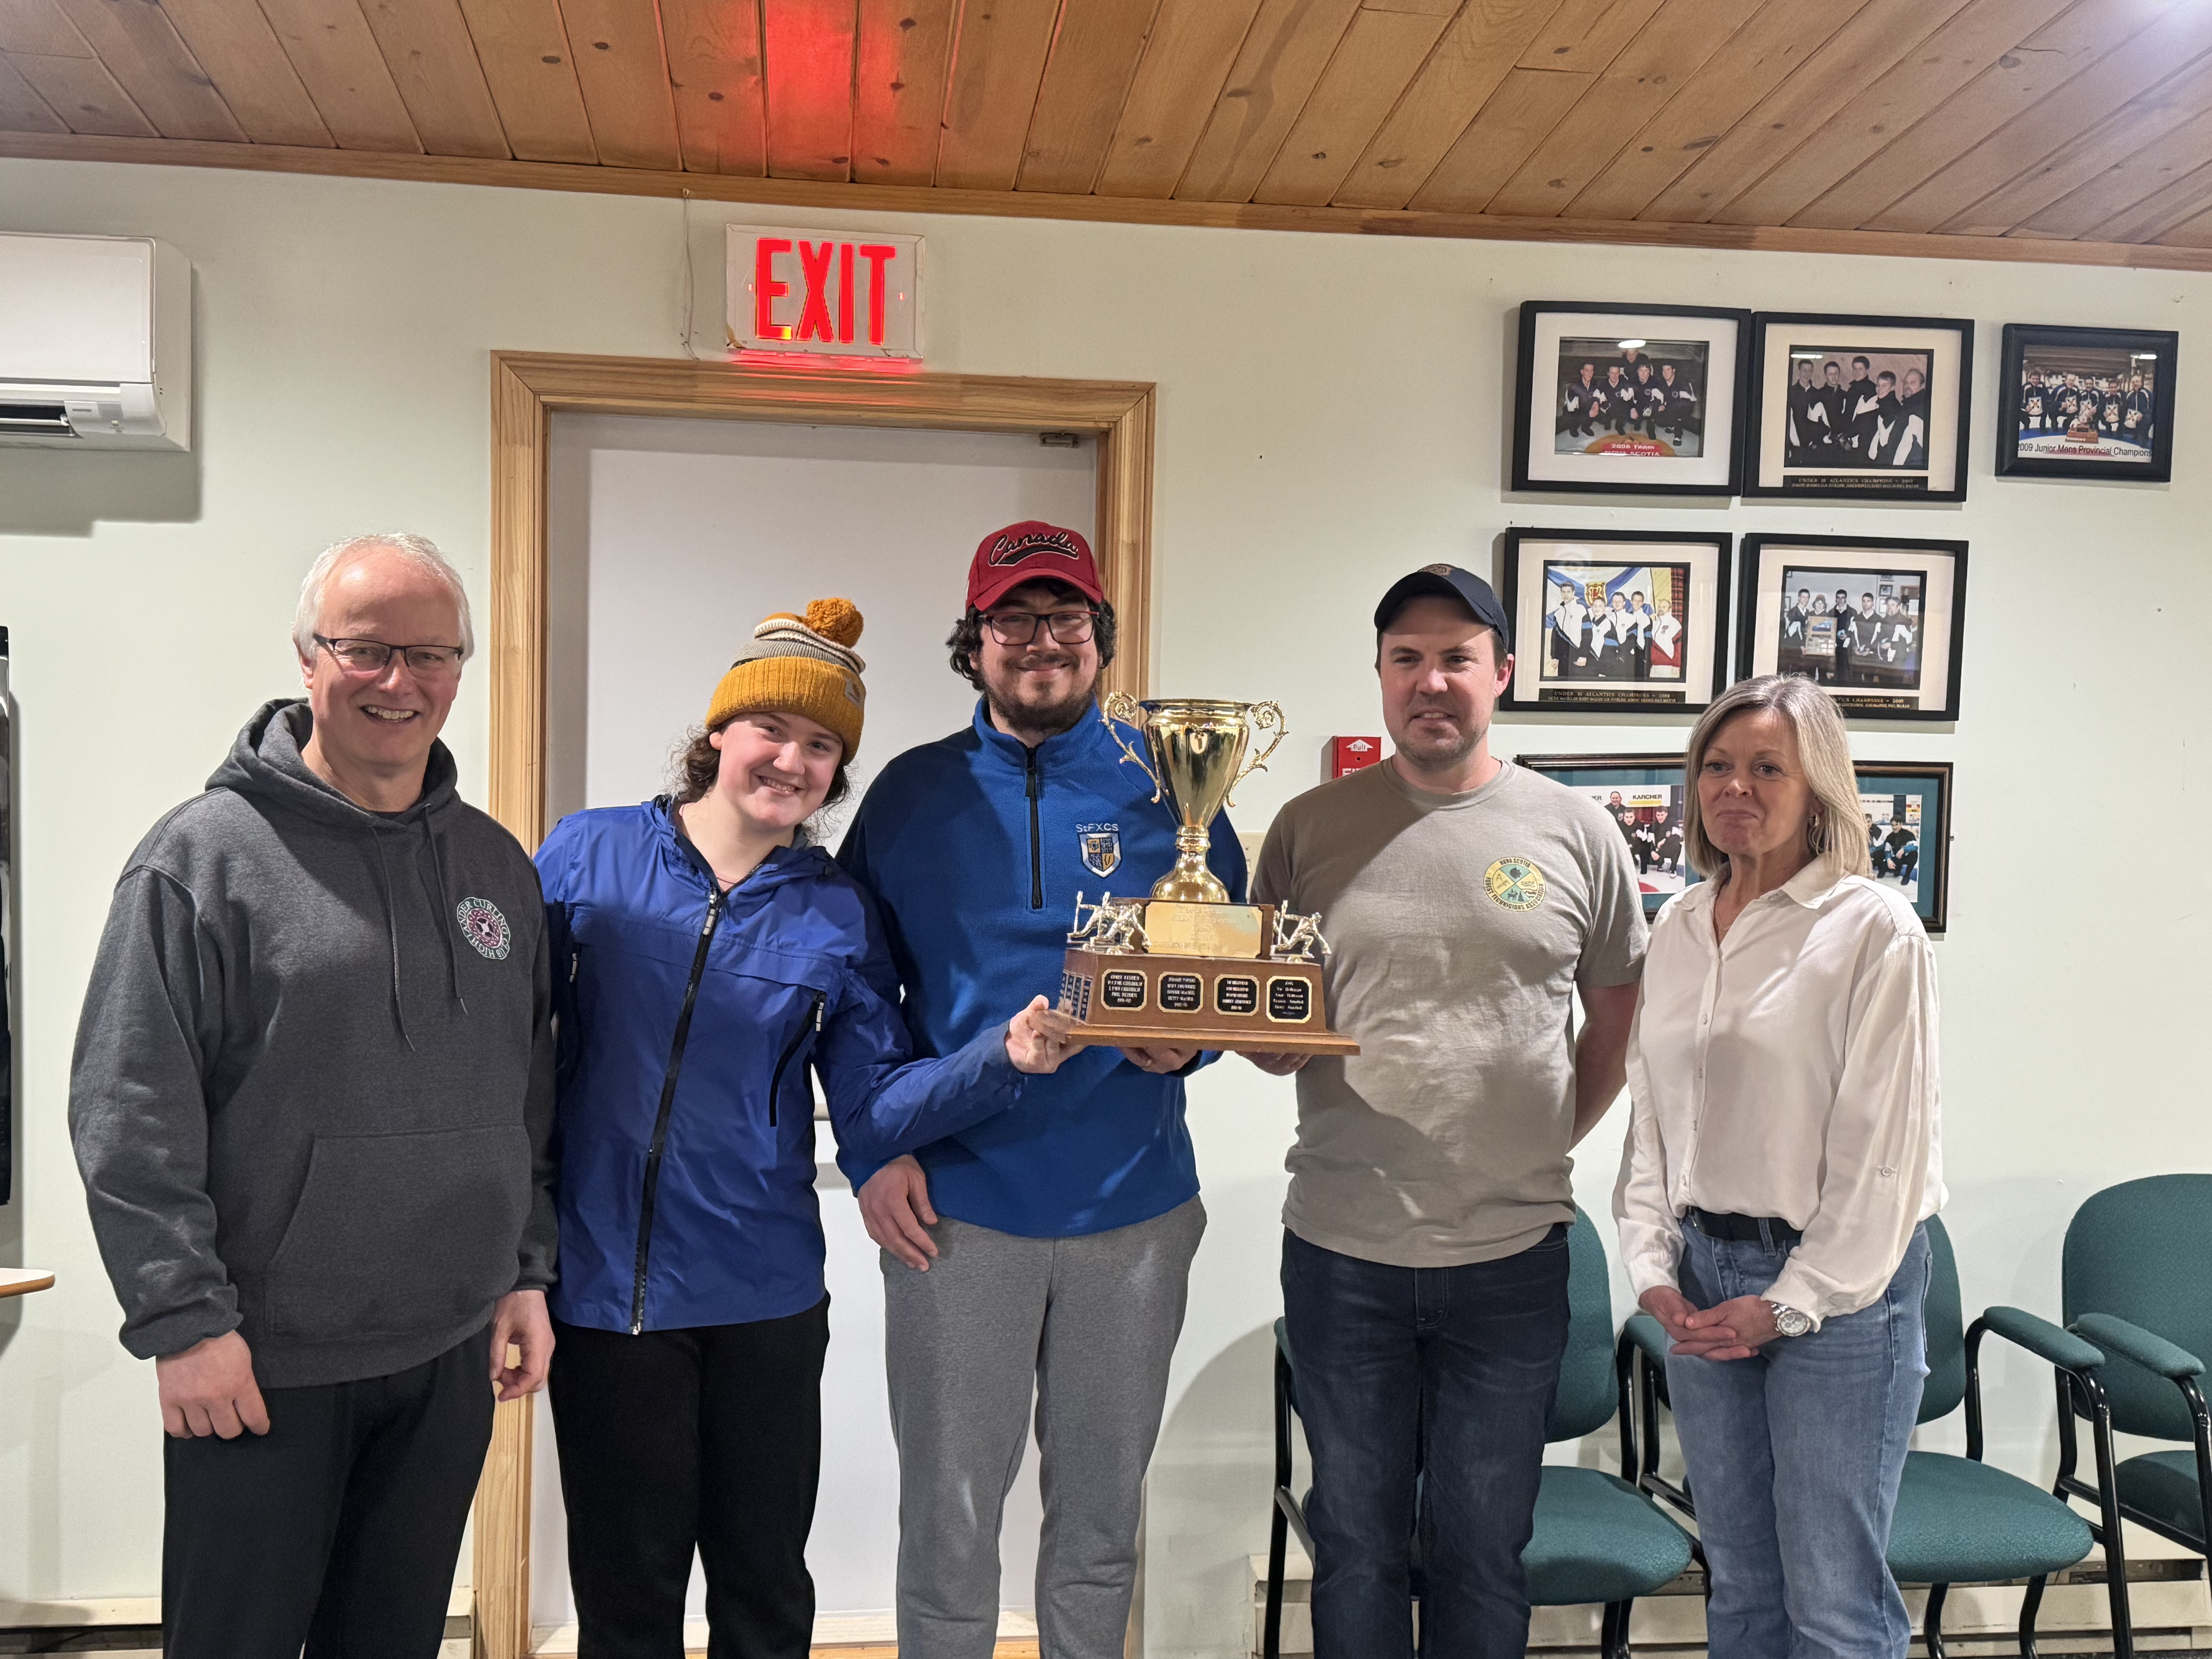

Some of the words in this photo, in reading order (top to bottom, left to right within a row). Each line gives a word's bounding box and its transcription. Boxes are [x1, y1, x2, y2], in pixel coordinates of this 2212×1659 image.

[755, 237, 897, 346] EXIT
[2035, 443, 2056, 452] Junior
[2058, 445, 2076, 453] Mens
[2078, 445, 2111, 455] Provincial
[2114, 447, 2152, 457] Champions
[988, 531, 1079, 567] Canada
[1075, 823, 1119, 833] StFXCS
[1513, 858, 1531, 868] SCOTIA
[1525, 883, 1544, 910] ASSOCIATION
[459, 900, 495, 958] HIGHLANDER
[473, 900, 508, 935] CURLING
